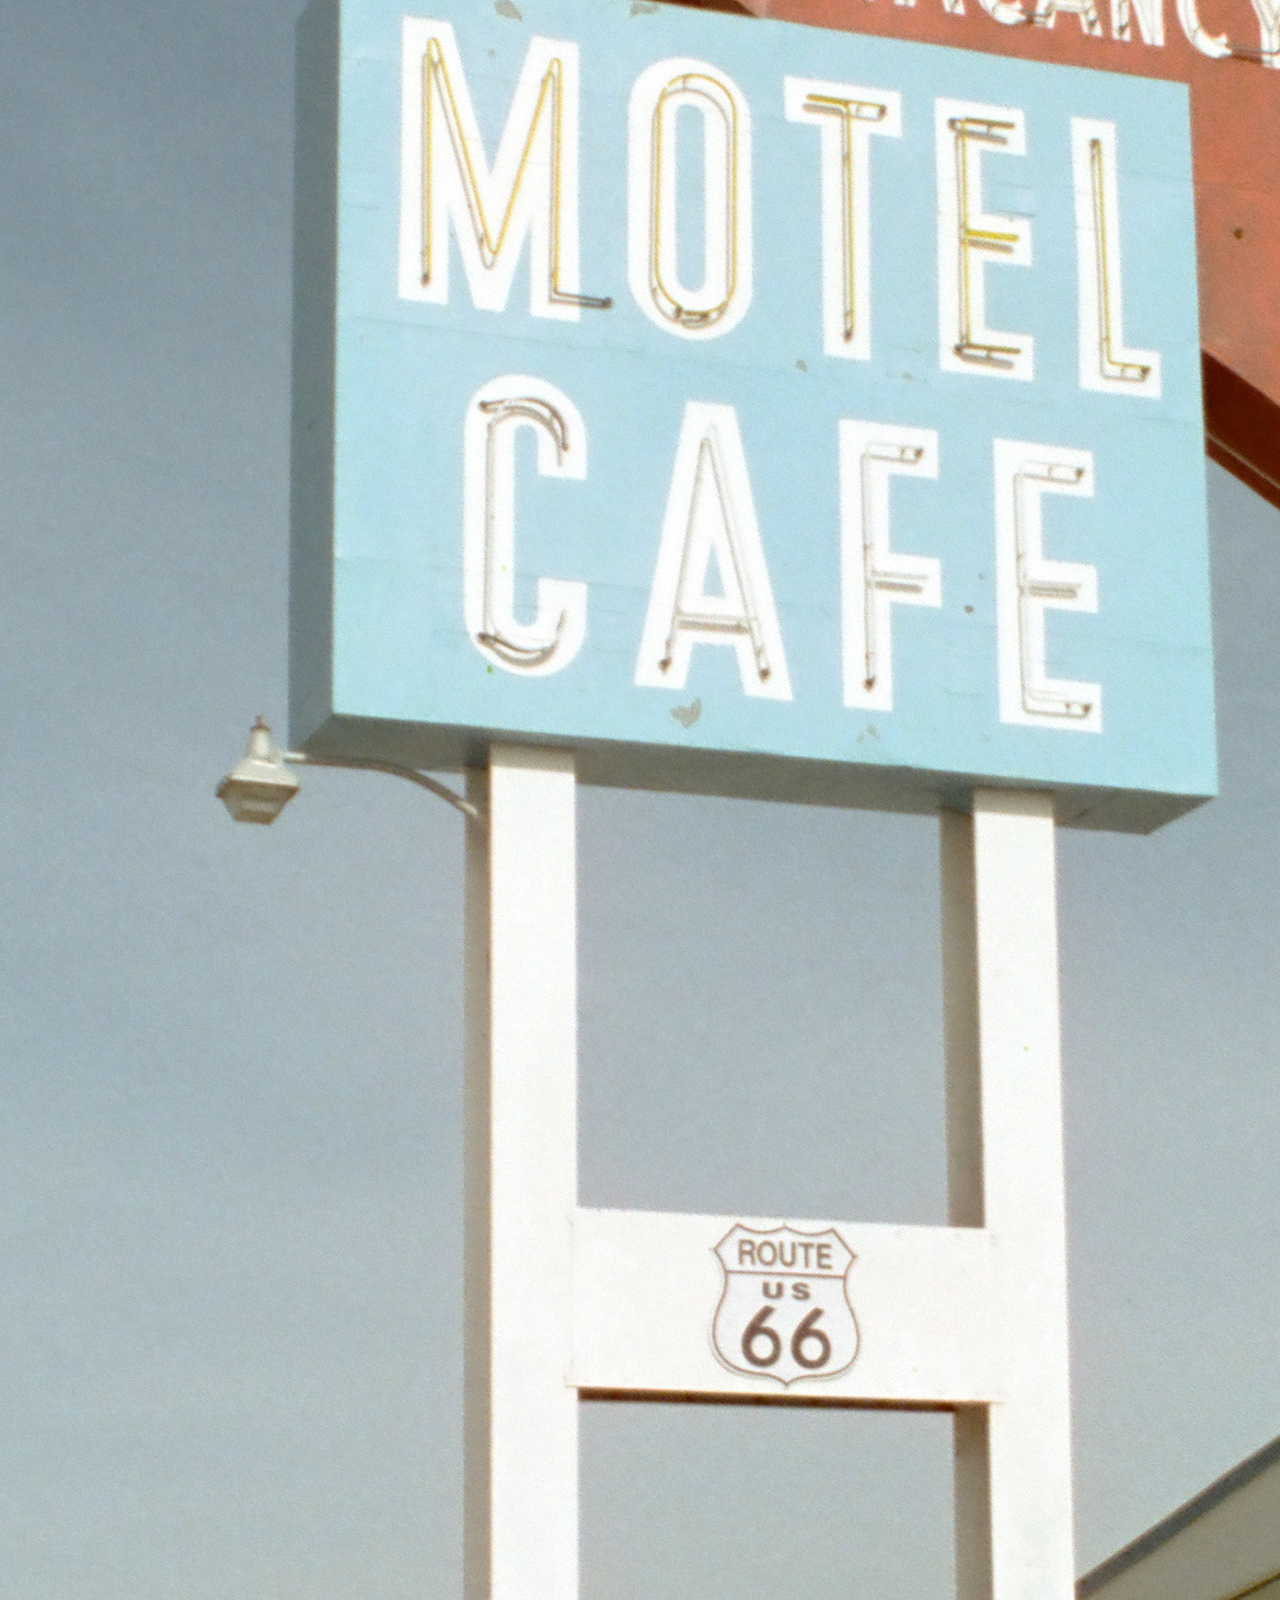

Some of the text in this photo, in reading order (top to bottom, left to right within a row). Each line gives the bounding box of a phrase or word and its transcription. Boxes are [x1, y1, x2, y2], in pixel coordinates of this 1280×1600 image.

[397, 16, 1161, 398] MOTEL
[463, 373, 1103, 734] CAFE
[738, 1239, 832, 1270] ROUTE
[741, 1305, 832, 1369] 66
